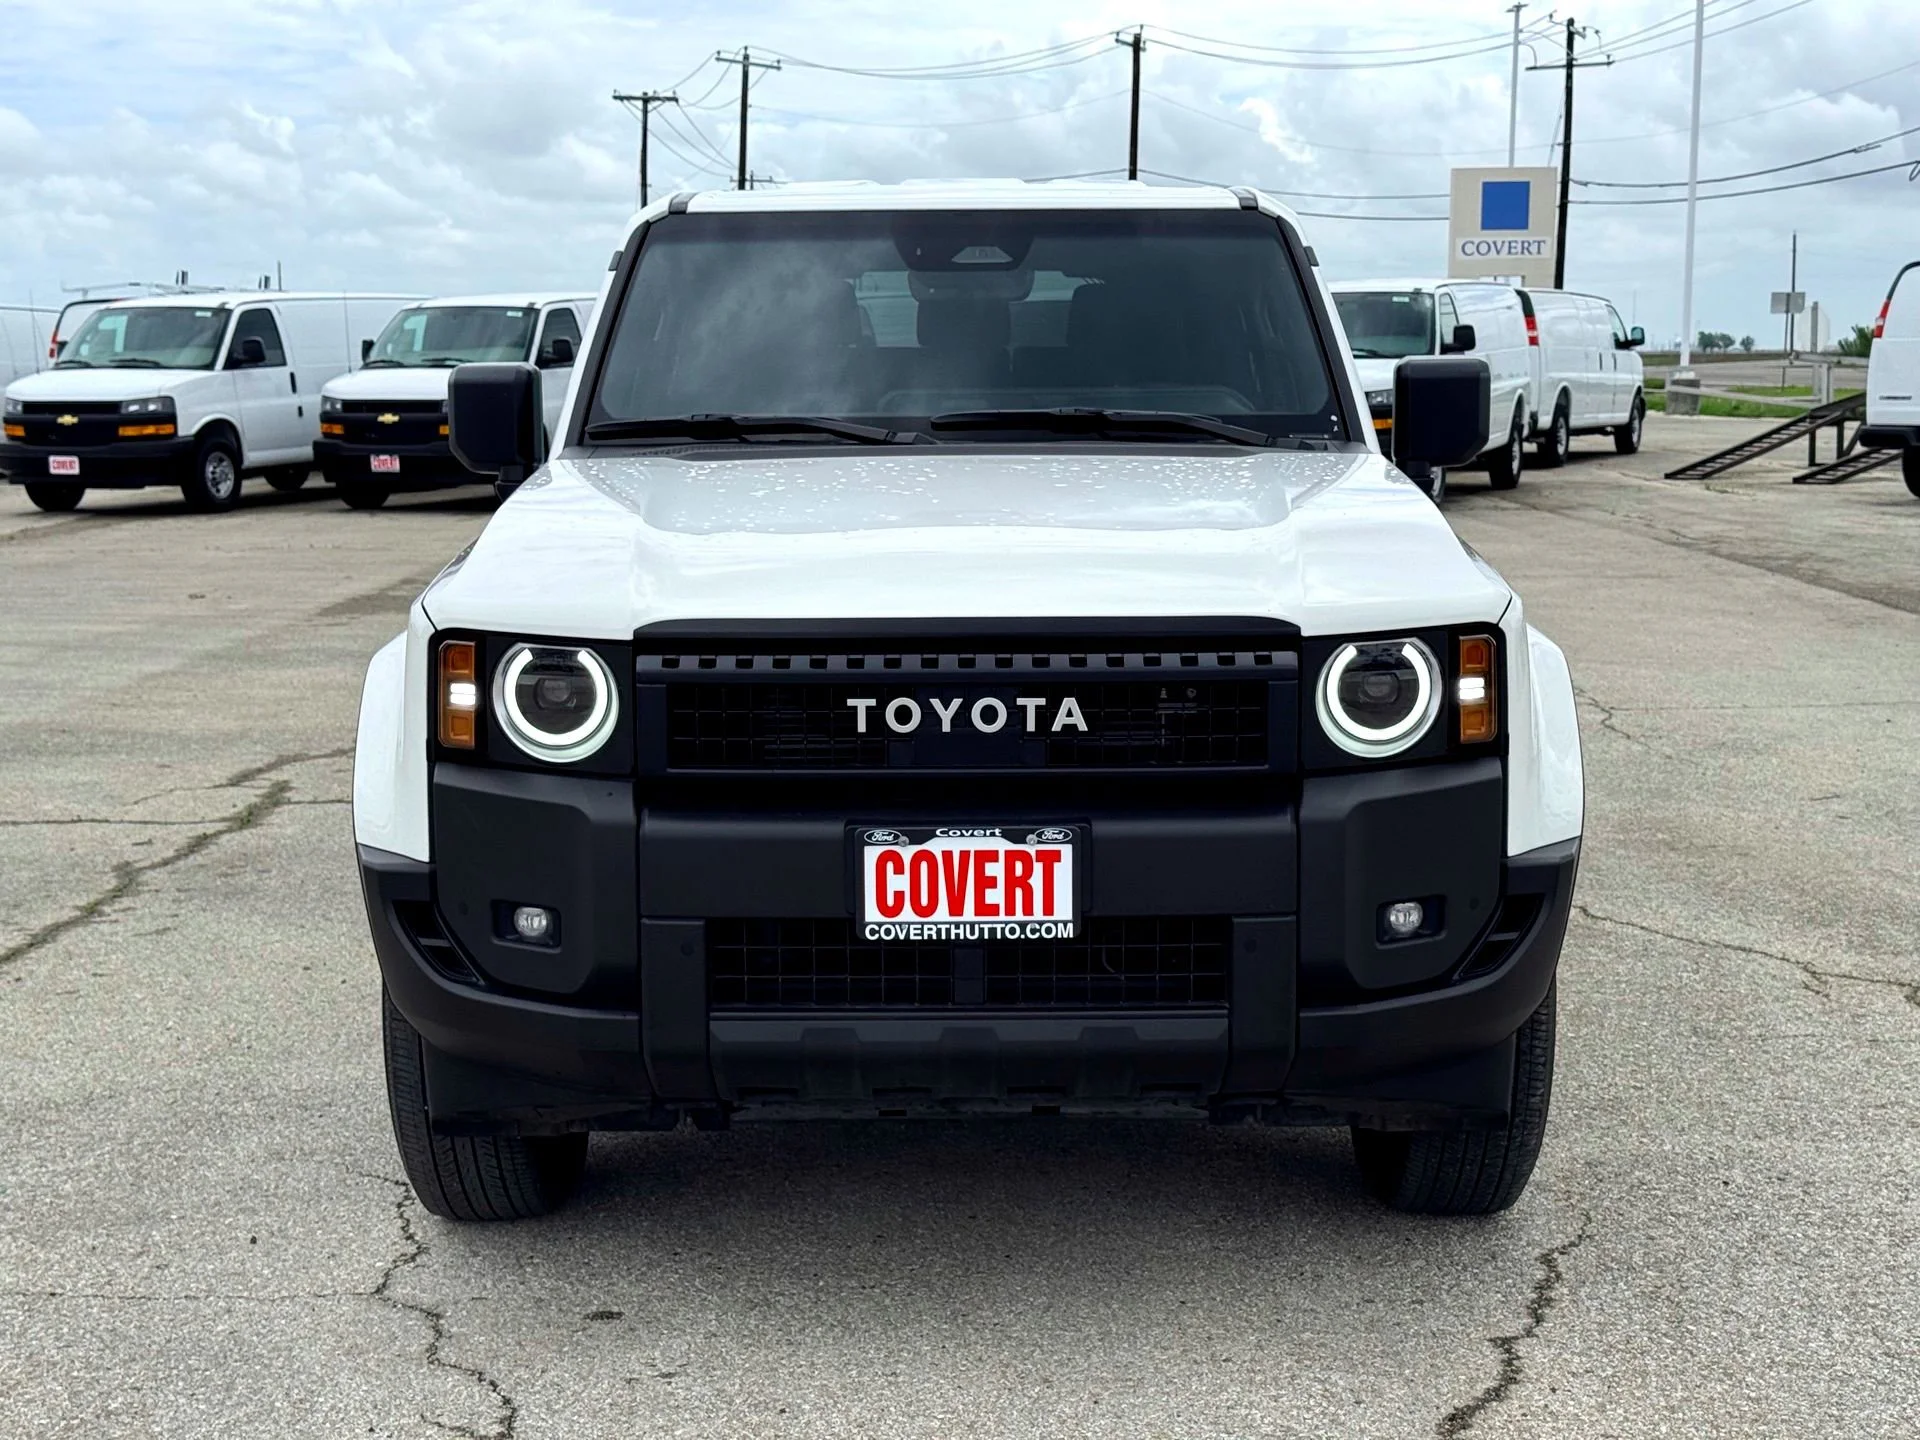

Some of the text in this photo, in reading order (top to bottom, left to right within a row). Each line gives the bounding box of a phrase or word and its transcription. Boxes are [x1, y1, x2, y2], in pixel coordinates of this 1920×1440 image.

[1460, 239, 1547, 257] COVERT
[846, 697, 1088, 734] TOYOTA
[871, 831, 895, 841] Ford
[935, 827, 1003, 838] Covert
[1041, 830, 1065, 840] Ford
[875, 849, 1062, 919] COVERT
[864, 922, 1075, 941] COVERTHUTTO.COM
